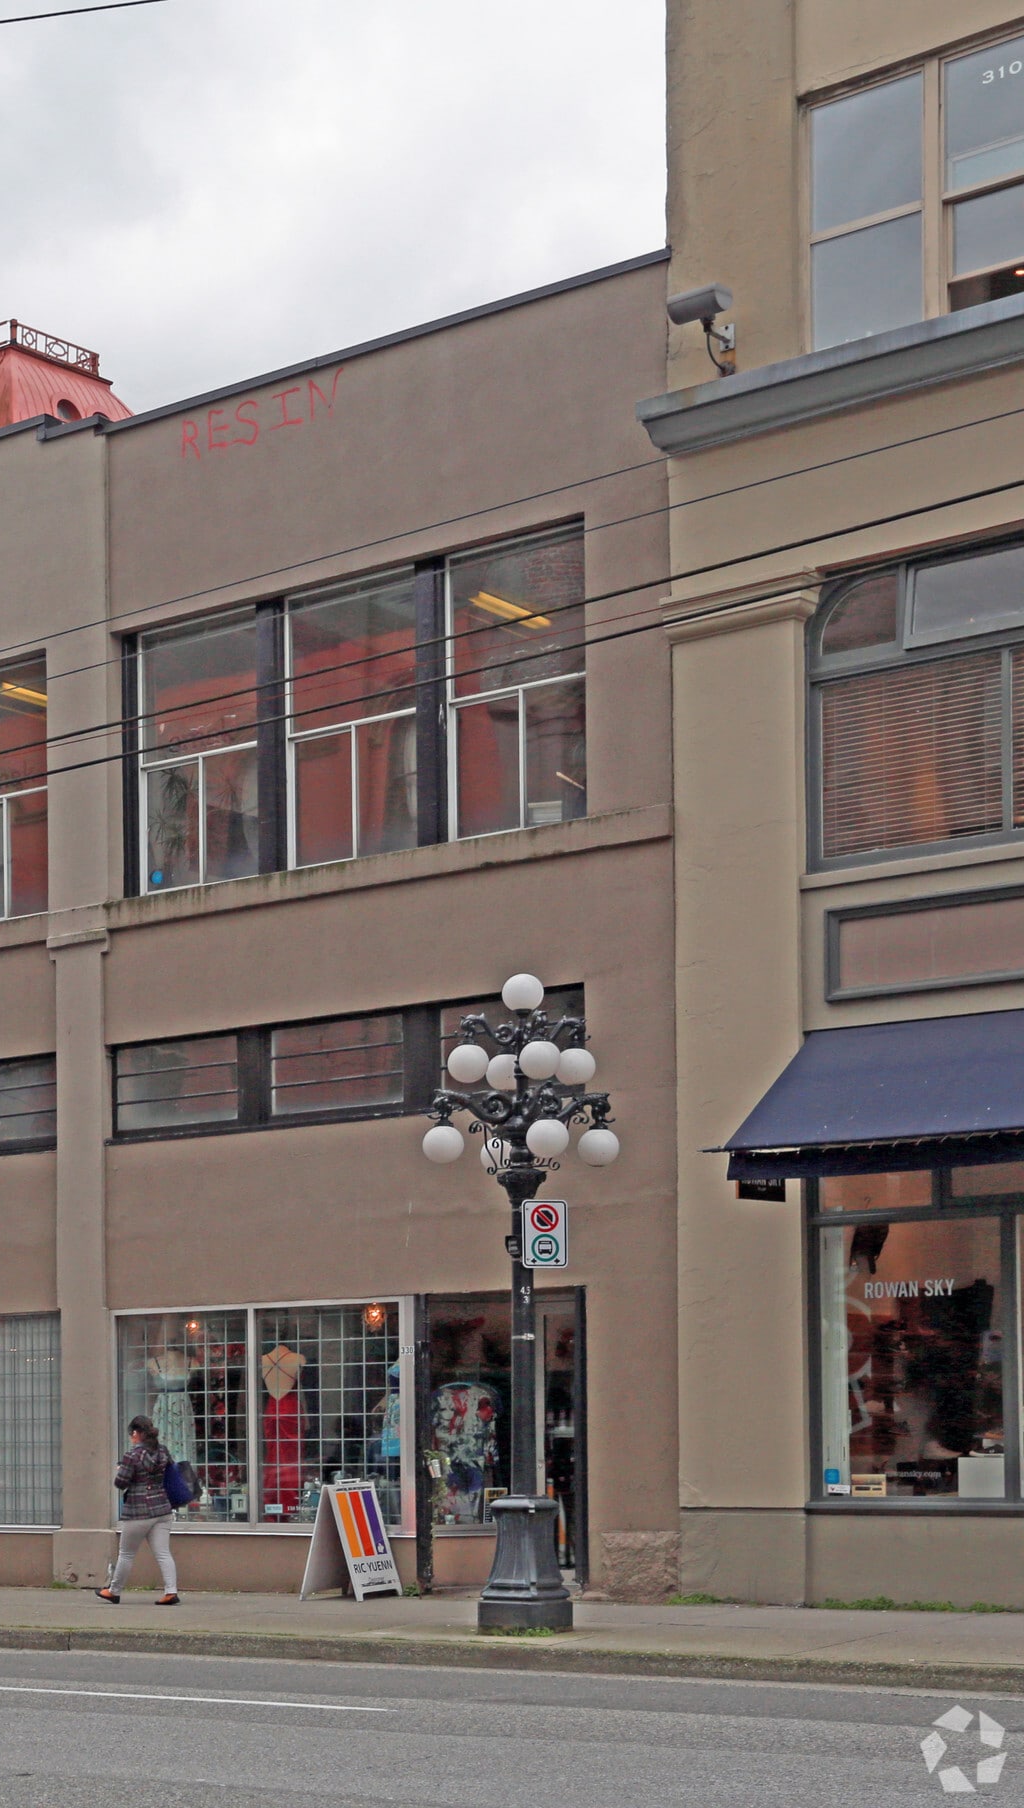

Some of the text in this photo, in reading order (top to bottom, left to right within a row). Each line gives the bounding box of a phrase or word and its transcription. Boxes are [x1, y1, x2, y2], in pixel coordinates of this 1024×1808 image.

[982, 61, 1022, 84] 310
[181, 367, 344, 460] RESIN
[864, 1279, 954, 1299] ROWAN SKY
[400, 1346, 414, 1355] 330
[353, 1560, 393, 1574] RIC YUENN
